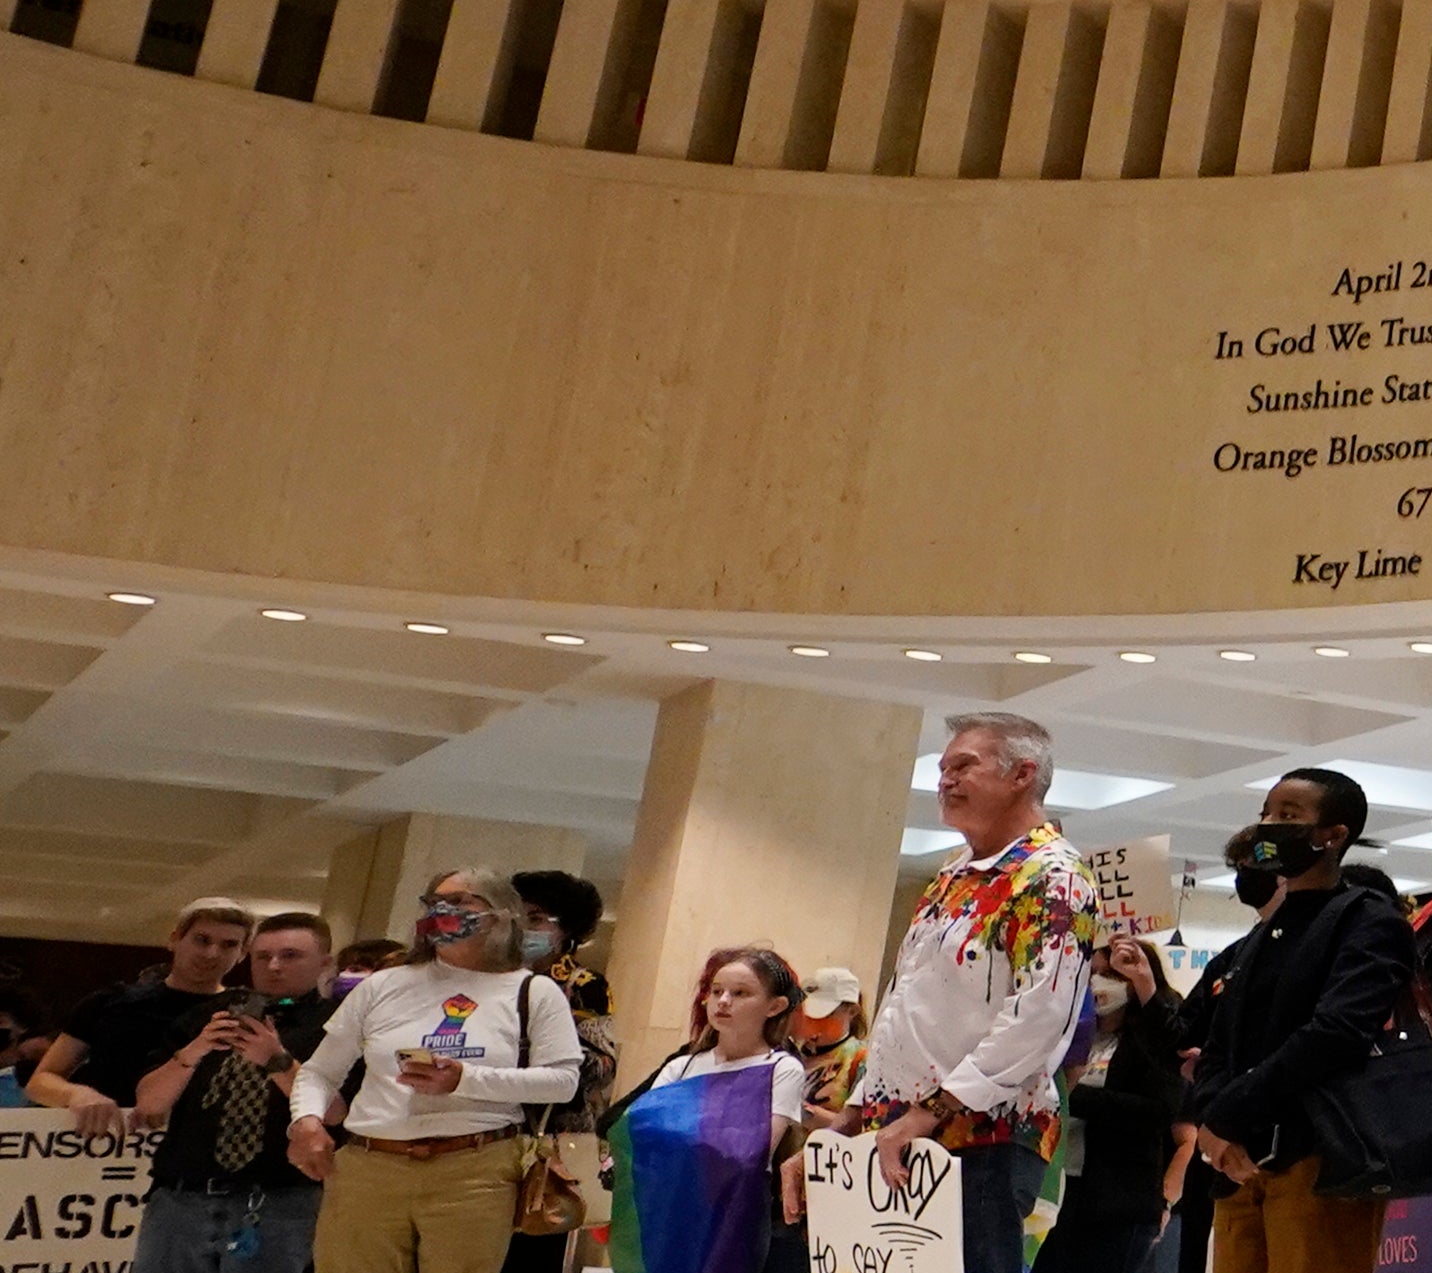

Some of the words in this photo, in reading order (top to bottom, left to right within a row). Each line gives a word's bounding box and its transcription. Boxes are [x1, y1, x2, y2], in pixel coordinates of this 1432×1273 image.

[1331, 262, 1401, 303] April
[1214, 332, 1243, 359] In
[1255, 324, 1316, 355] God
[1327, 323, 1371, 352] We
[1246, 381, 1373, 414] Sunshine
[1213, 443, 1318, 478] Orange
[1396, 487, 1432, 518] 67
[1292, 554, 1349, 590] Key
[1355, 549, 1423, 579] Lime
[425, 1034, 464, 1048] PRIDE
[807, 1142, 852, 1190] It's
[1378, 1235, 1418, 1265] LOVES
